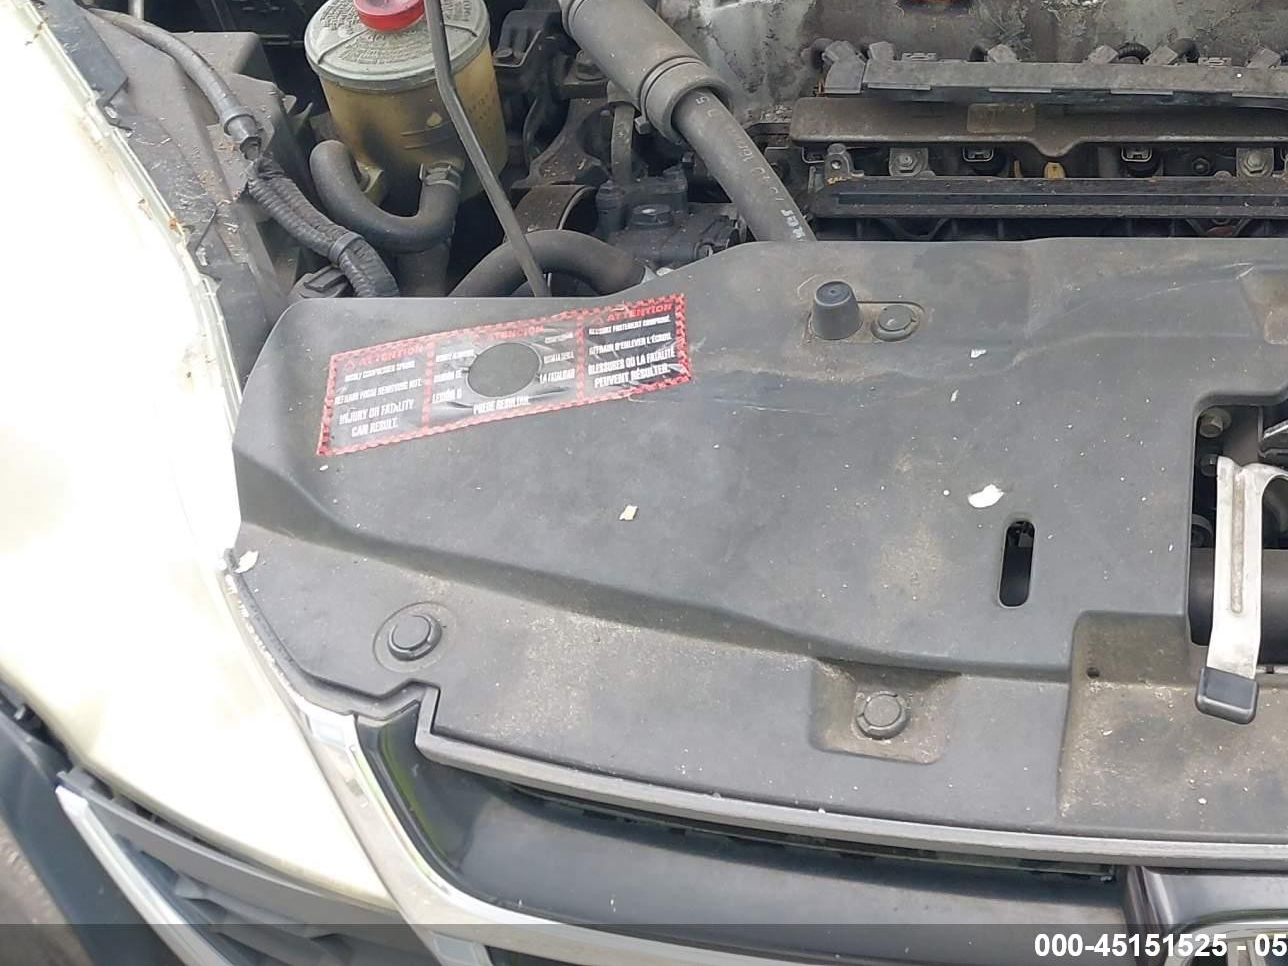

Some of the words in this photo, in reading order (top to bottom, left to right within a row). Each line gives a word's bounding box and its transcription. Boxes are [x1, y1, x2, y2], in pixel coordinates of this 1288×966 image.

[636, 354, 646, 366] LA
[369, 406, 380, 418] OR
[381, 399, 415, 416] FATALITY
